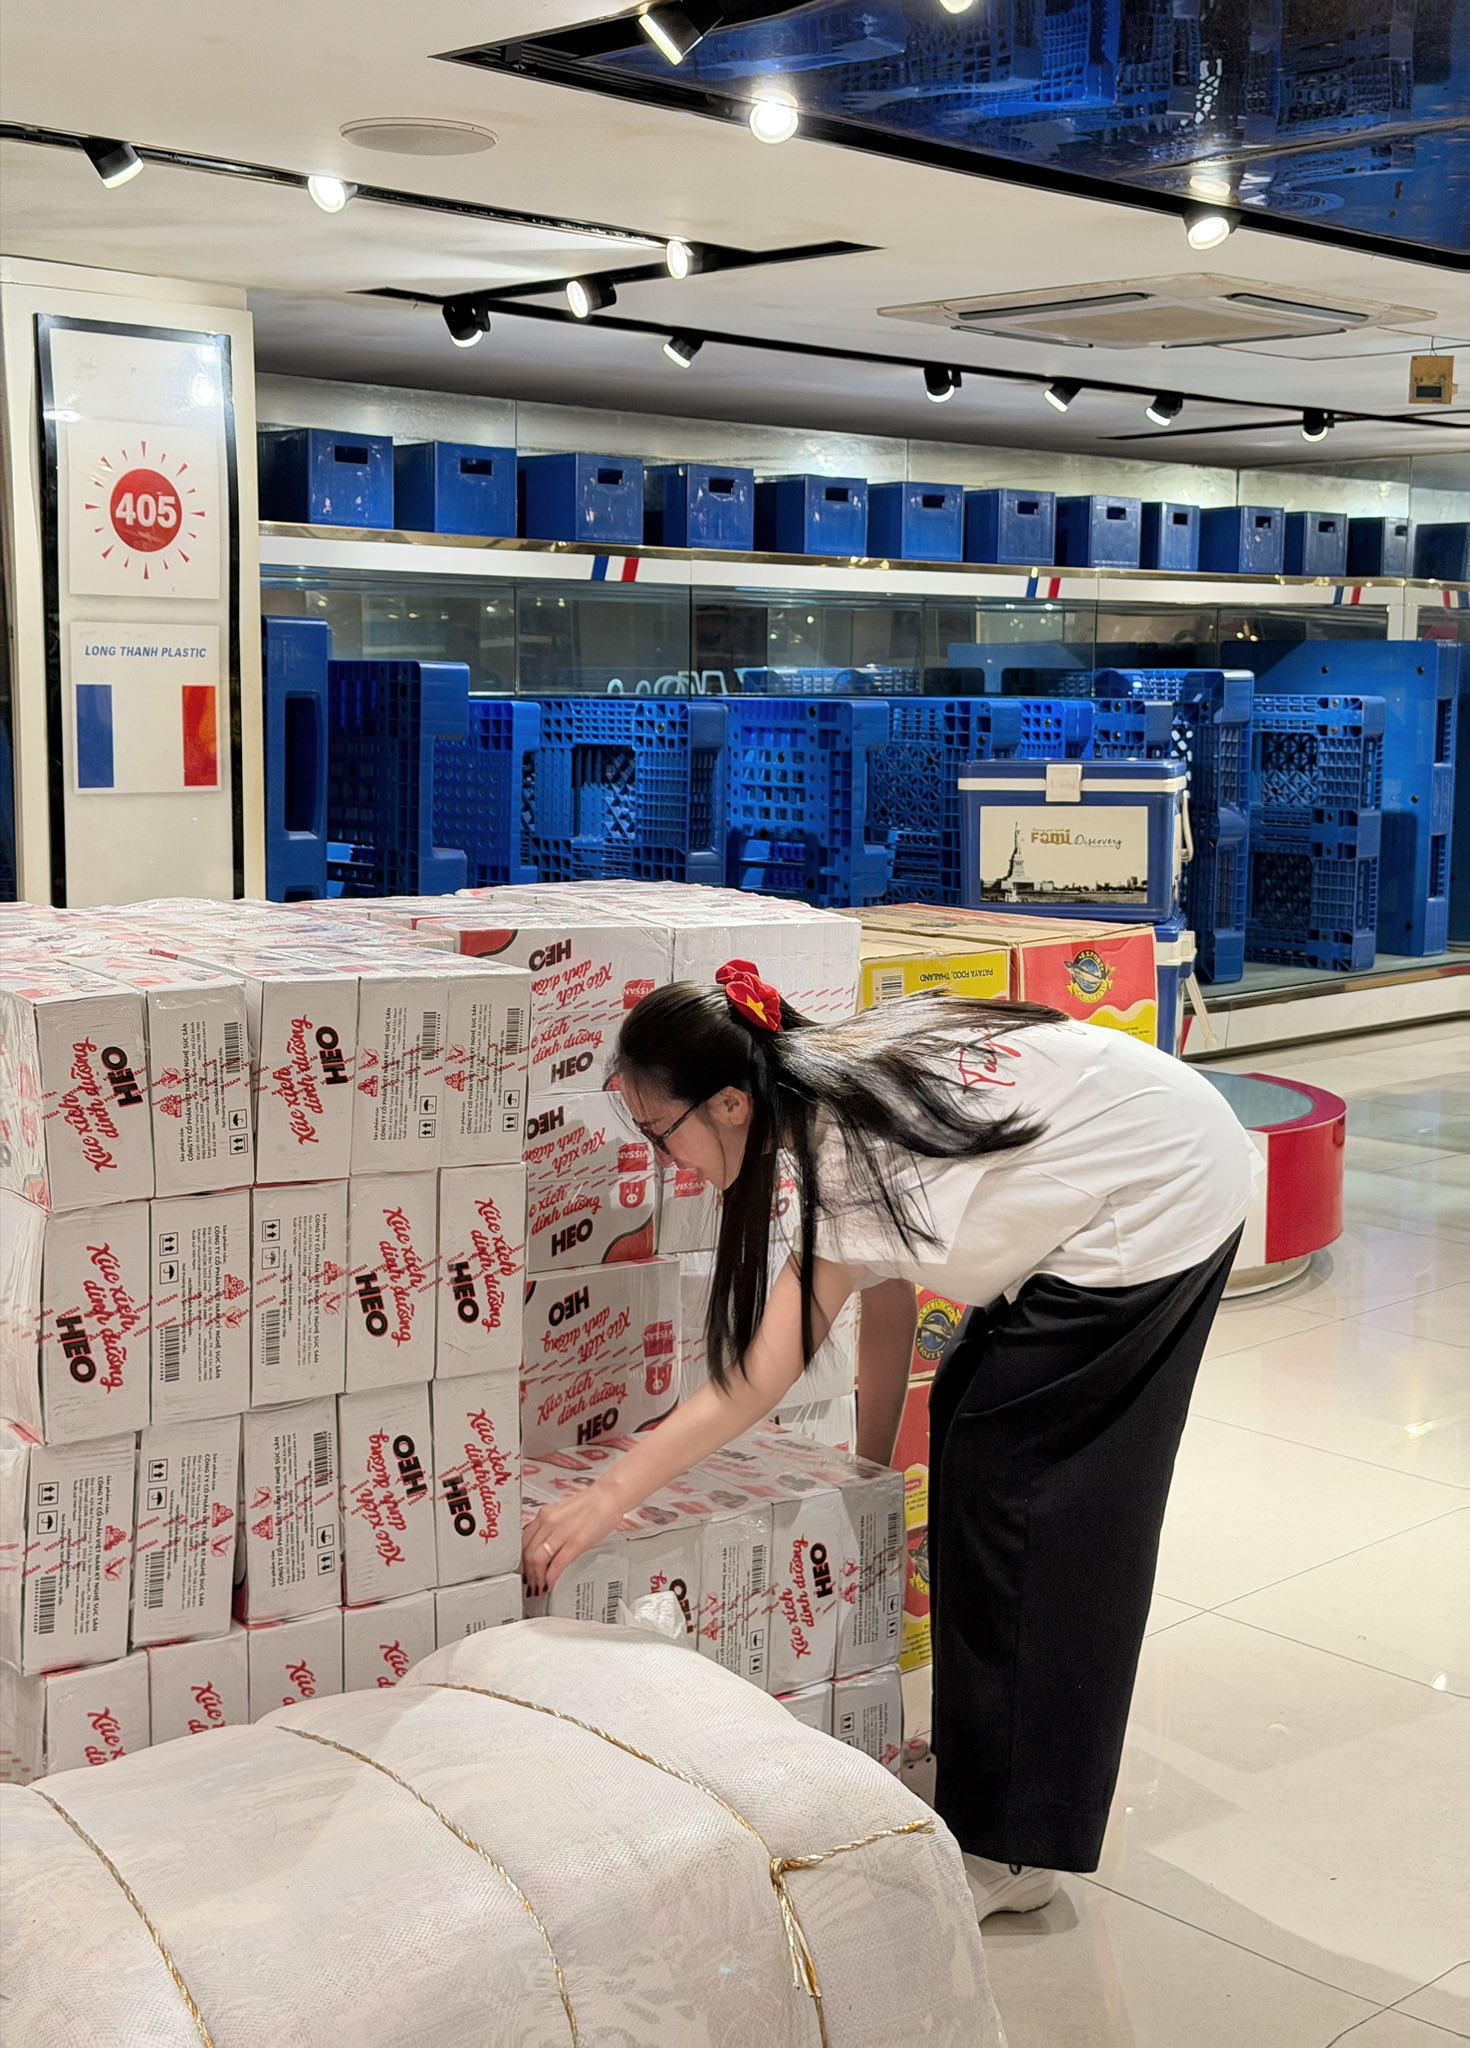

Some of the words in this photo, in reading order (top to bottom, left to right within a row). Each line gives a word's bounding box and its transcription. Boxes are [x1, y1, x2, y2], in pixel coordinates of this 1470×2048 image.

[115, 492, 177, 529] 405
[85, 646, 117, 657] LONG
[120, 646, 159, 658] THANH
[161, 646, 207, 659] PLASTIC
[1074, 834, 1123, 849] Discovery
[529, 939, 571, 972] HEO
[561, 960, 591, 984] dinh
[970, 968, 993, 978] PATAYA
[531, 974, 560, 996] dưỡn
[587, 962, 612, 989] Xúc
[623, 987, 655, 998] VISSAN
[920, 972, 950, 982] THAILAND
[951, 970, 969, 979] FOOD,
[556, 981, 585, 1006] xích
[540, 1020, 570, 1044] xích
[315, 1026, 348, 1085] HEO
[532, 1038, 563, 1065] dinh
[551, 1052, 593, 1084] HEO
[101, 1046, 143, 1108] HEO
[272, 1066, 300, 1108] xích
[299, 1073, 323, 1114] dinh
[58, 1094, 93, 1135] xích
[85, 1098, 119, 1138] dinh
[289, 1109, 319, 1145] Xúc
[527, 1105, 565, 1140] HEO
[81, 1136, 118, 1172] Xúc
[522, 1143, 555, 1164] dưỡn
[556, 1126, 585, 1150] dinh
[580, 1127, 606, 1156] Xúc
[617, 1150, 648, 1159] VISSAN
[551, 1147, 580, 1173] xích
[538, 1188, 566, 1212] xích
[674, 1182, 706, 1191] VISSAN
[474, 1198, 502, 1234] Xúc
[493, 1234, 516, 1276] xích
[531, 1206, 561, 1235] dinh
[551, 1218, 593, 1258] HEO
[379, 1241, 405, 1283] dinh
[383, 1206, 412, 1244] Xúc
[401, 1245, 427, 1288] xích
[471, 1230, 495, 1272] dinh
[83, 1280, 115, 1325] dinh
[86, 1242, 121, 1284] Xúc
[109, 1285, 141, 1330] xích
[447, 1261, 479, 1323] HEO
[355, 1272, 388, 1337] HEO
[548, 1285, 590, 1327] HEO
[581, 1306, 610, 1337] dinh
[606, 1306, 631, 1340] Xúc
[55, 1315, 97, 1383] HEO
[577, 1331, 606, 1364] xích
[537, 1392, 563, 1426] Xúc
[565, 1370, 594, 1400] xích
[558, 1397, 587, 1426] dinh
[576, 1407, 619, 1446] HEO
[464, 1443, 491, 1484] dinh
[466, 1408, 495, 1444] Xúc
[486, 1445, 513, 1486] xích
[392, 1435, 428, 1498] HEO
[356, 1489, 384, 1530] xích
[378, 1492, 407, 1531] dinh
[442, 1474, 476, 1537] HEO
[375, 1530, 405, 1567] Xúc
[810, 1543, 833, 1598] HEO
[779, 1588, 799, 1625] xích
[796, 1591, 815, 1628] dinh
[790, 1626, 811, 1659] Xúc
